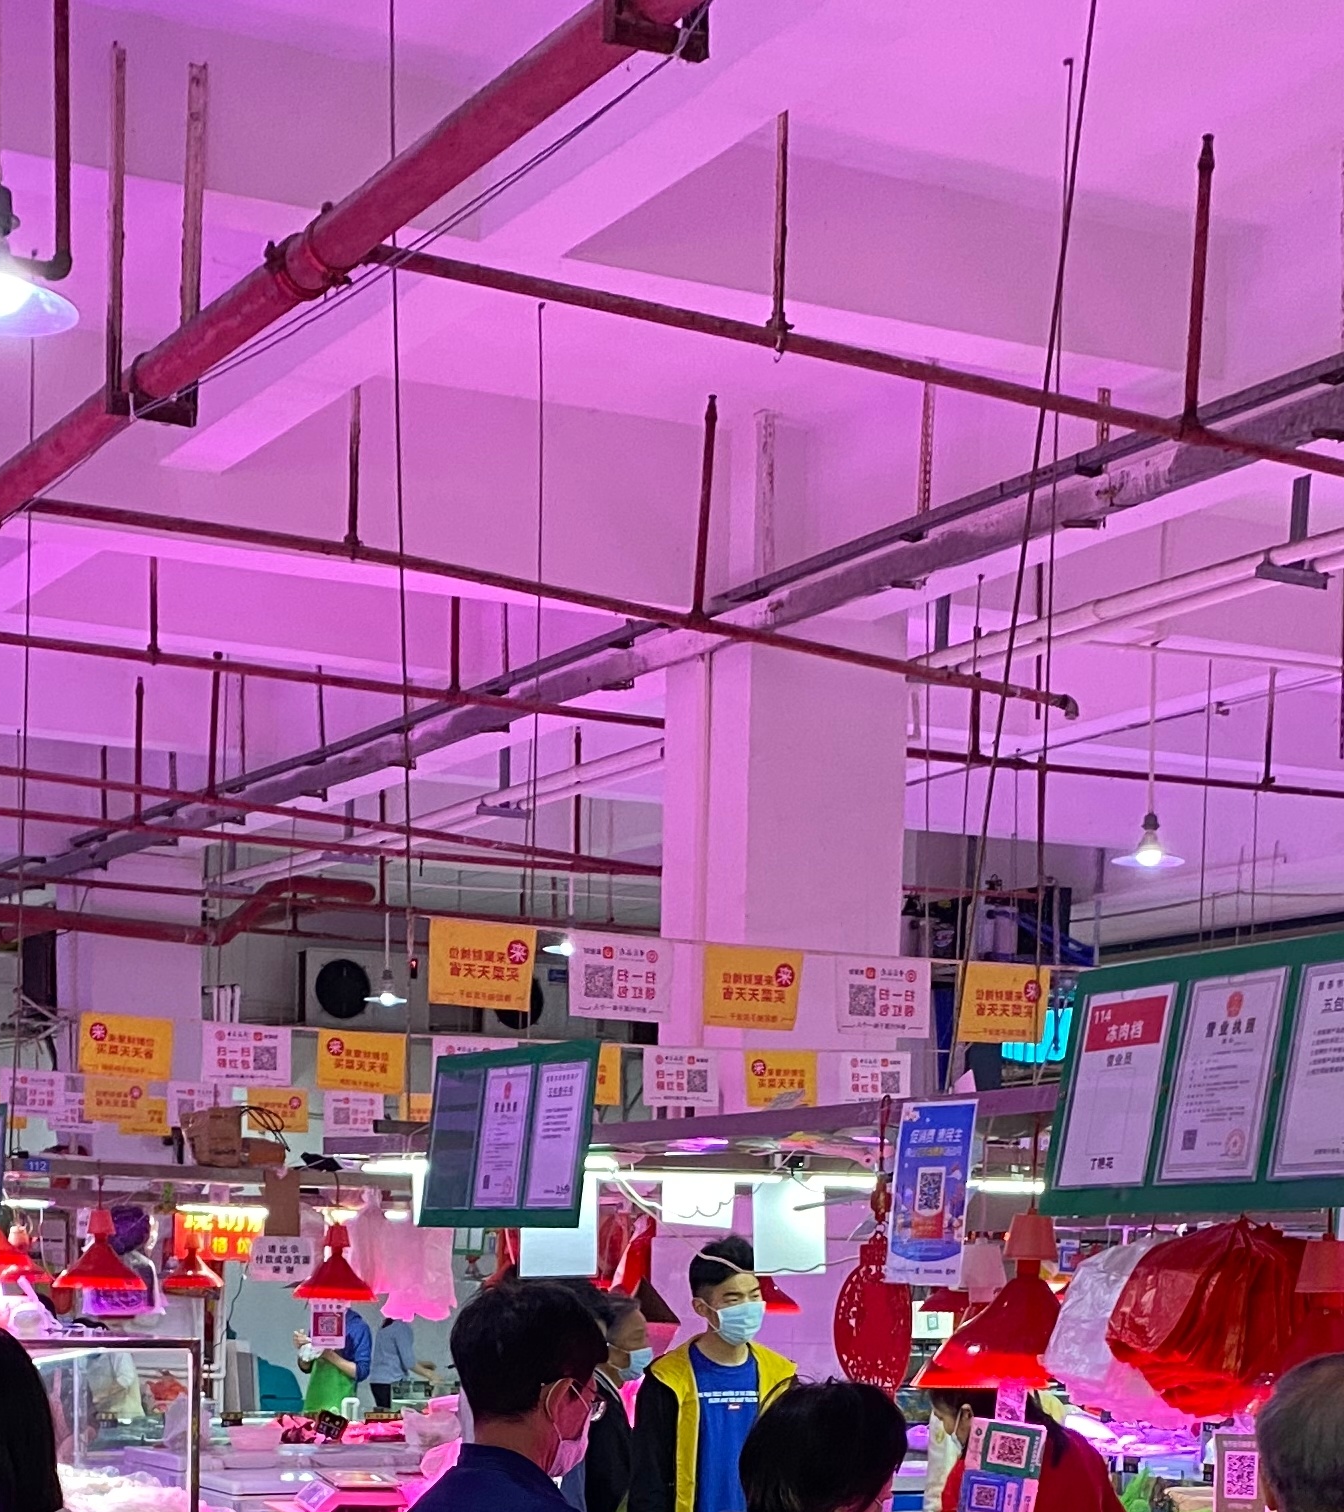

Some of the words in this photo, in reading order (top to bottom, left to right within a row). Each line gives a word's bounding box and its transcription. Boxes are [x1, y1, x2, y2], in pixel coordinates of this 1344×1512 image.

[1094, 1010, 1112, 1025] 114
[1106, 1020, 1144, 1043] 冻肉档
[28, 1161, 47, 1171] 112
[268, 1244, 299, 1254] 请出示
[256, 1256, 310, 1265] 付款成功页面
